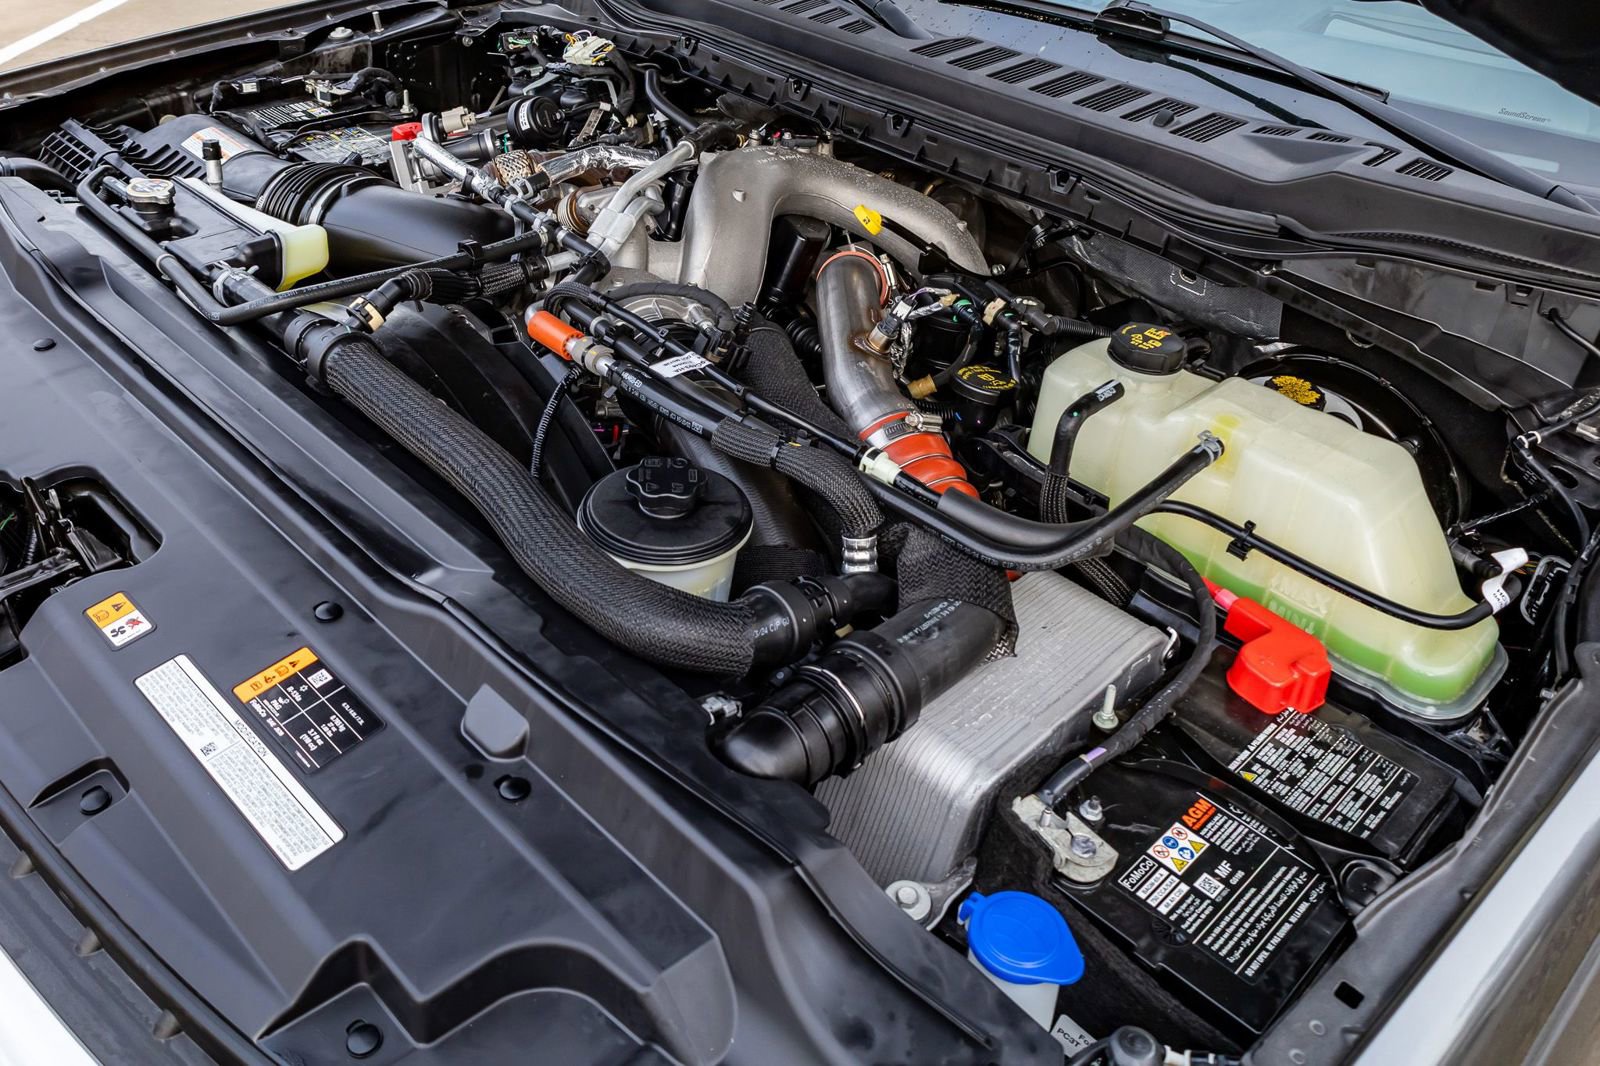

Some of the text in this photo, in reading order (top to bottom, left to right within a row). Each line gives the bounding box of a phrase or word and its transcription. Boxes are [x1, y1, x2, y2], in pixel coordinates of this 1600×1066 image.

[1498, 107, 1546, 123] SoundScreen
[235, 720, 267, 757] MODIFICATION
[1182, 799, 1212, 827] AGM
[1122, 858, 1154, 889] FoMoCo
[1214, 860, 1232, 878] MF
[1056, 1028, 1081, 1047] PC3T
